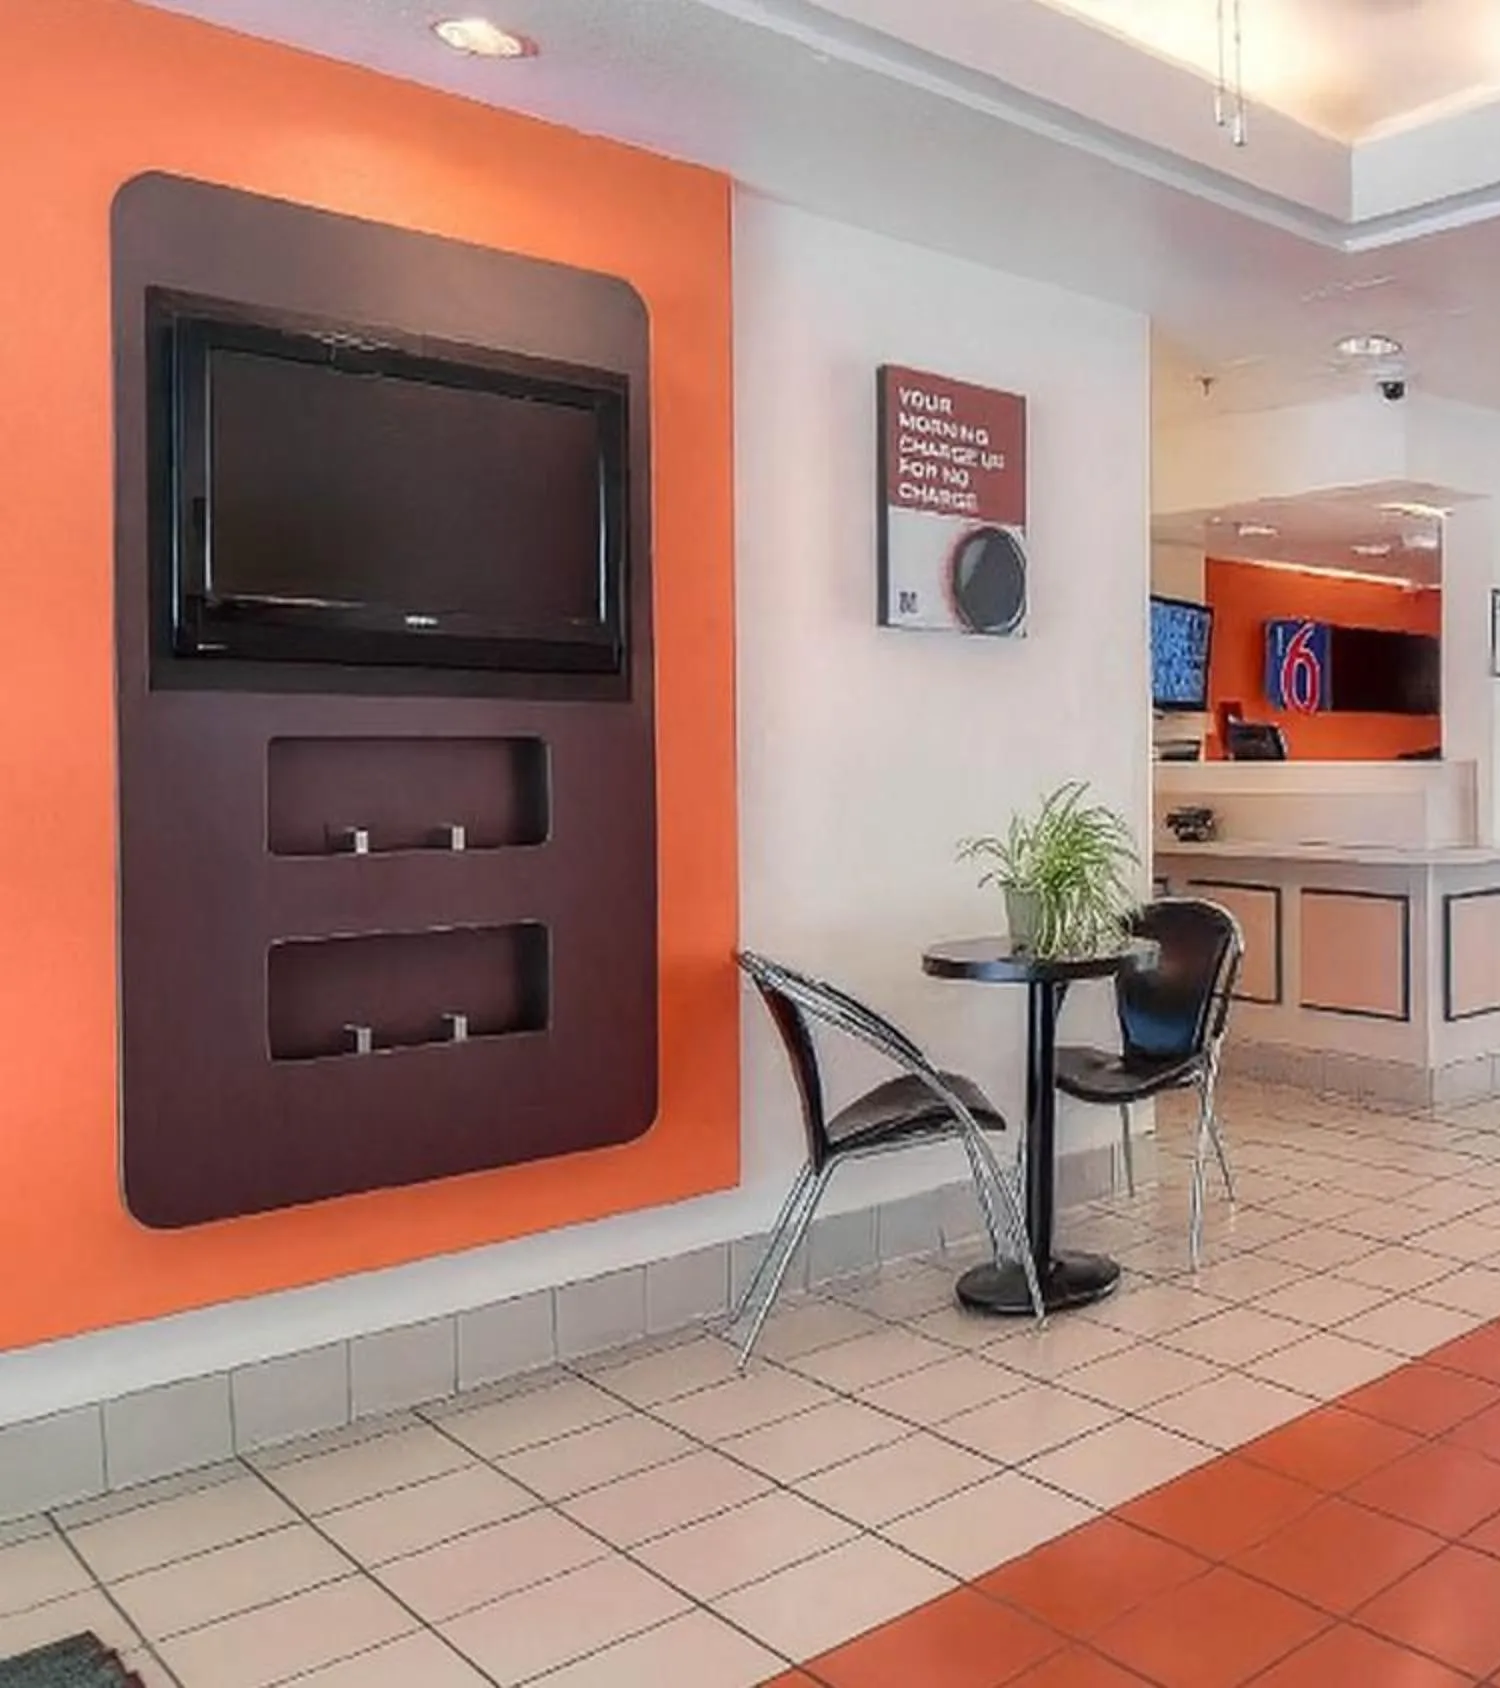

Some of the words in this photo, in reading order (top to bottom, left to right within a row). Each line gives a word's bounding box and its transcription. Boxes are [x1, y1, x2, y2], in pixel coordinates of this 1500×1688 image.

[899, 387, 952, 415] YOUR
[899, 412, 989, 446] MORNING
[899, 435, 978, 467] CHARGE
[899, 458, 937, 480] FOR
[941, 465, 969, 488] NO
[899, 482, 979, 511] CHARGE
[1280, 621, 1321, 714] 6
